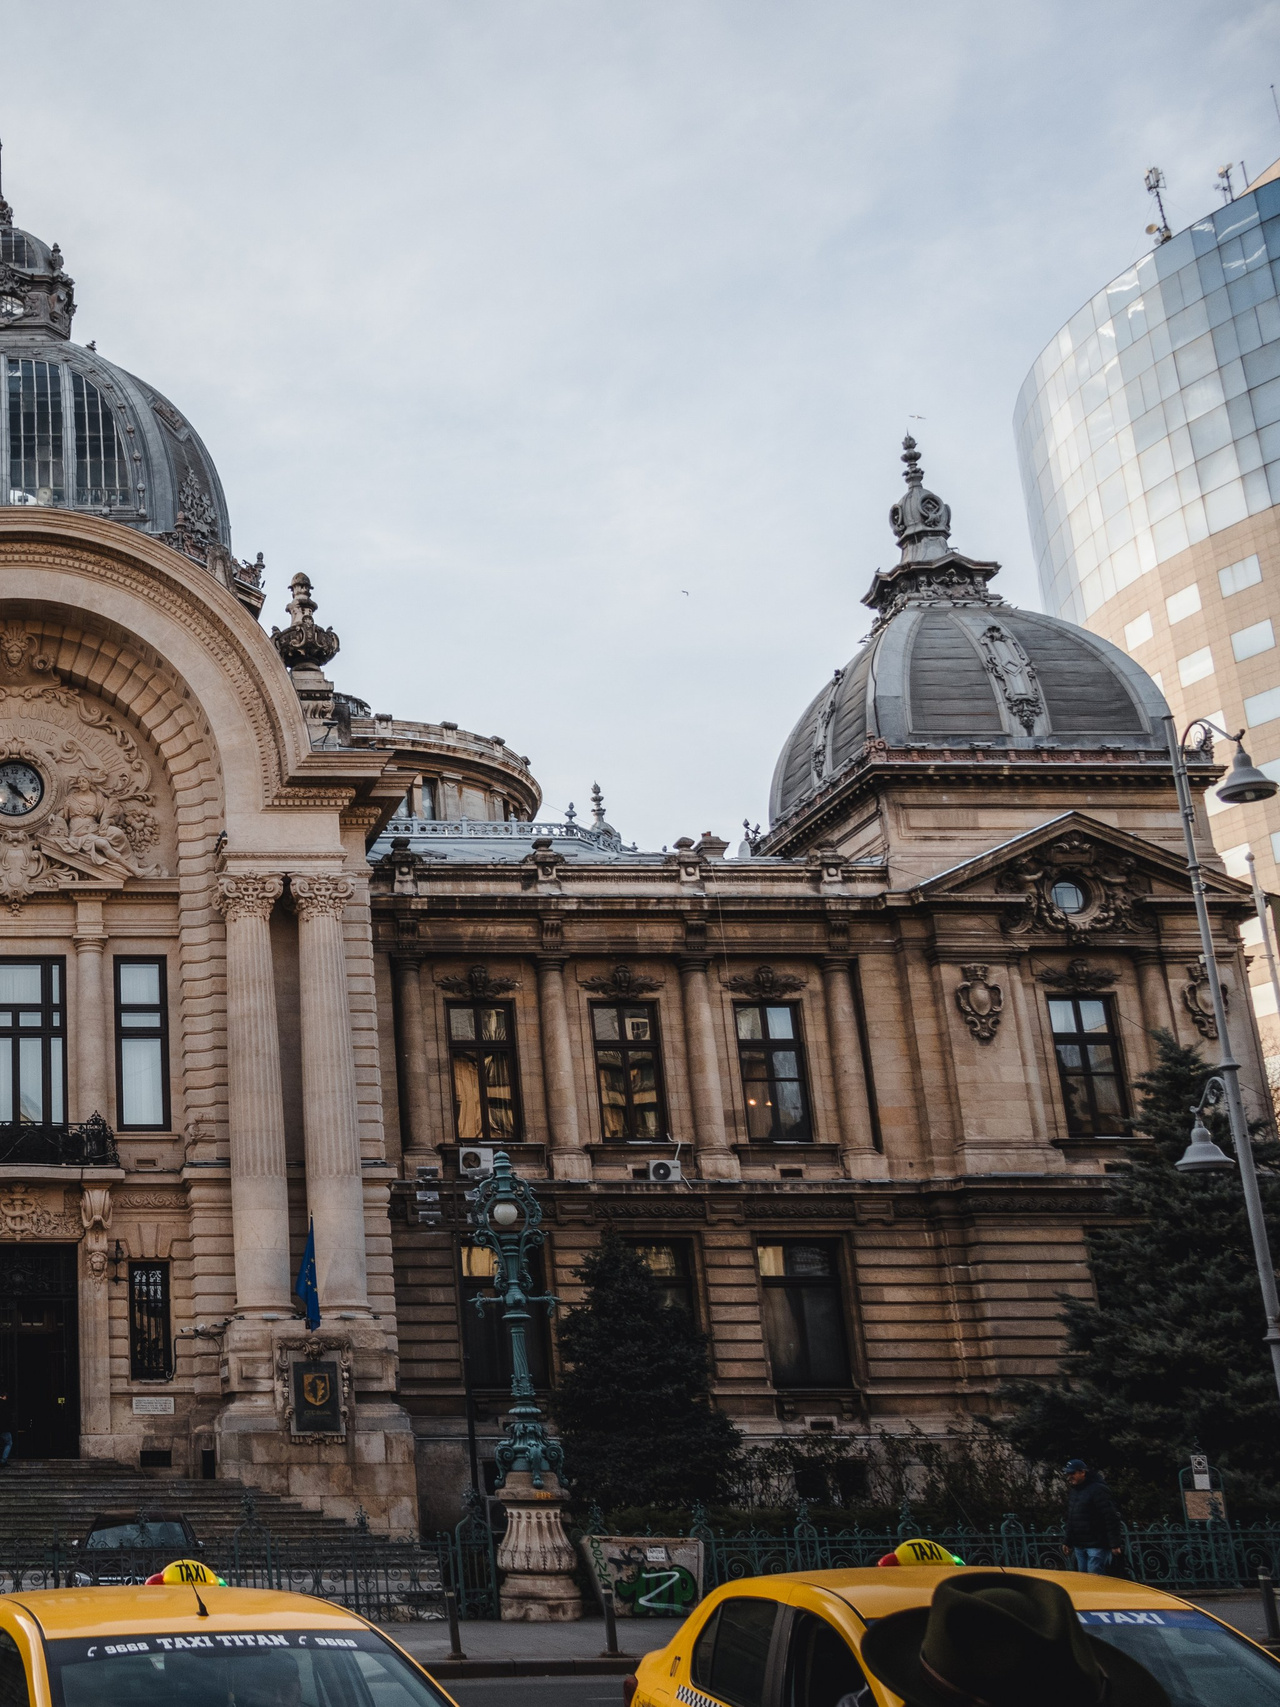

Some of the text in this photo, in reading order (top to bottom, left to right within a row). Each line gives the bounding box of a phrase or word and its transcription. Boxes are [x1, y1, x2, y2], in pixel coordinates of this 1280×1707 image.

[906, 1542, 943, 1560] TAXI
[175, 1564, 207, 1583] TAXI
[1090, 1612, 1166, 1625] TAXI
[104, 1634, 358, 1655] 9668 TAXI TITAN 9668
